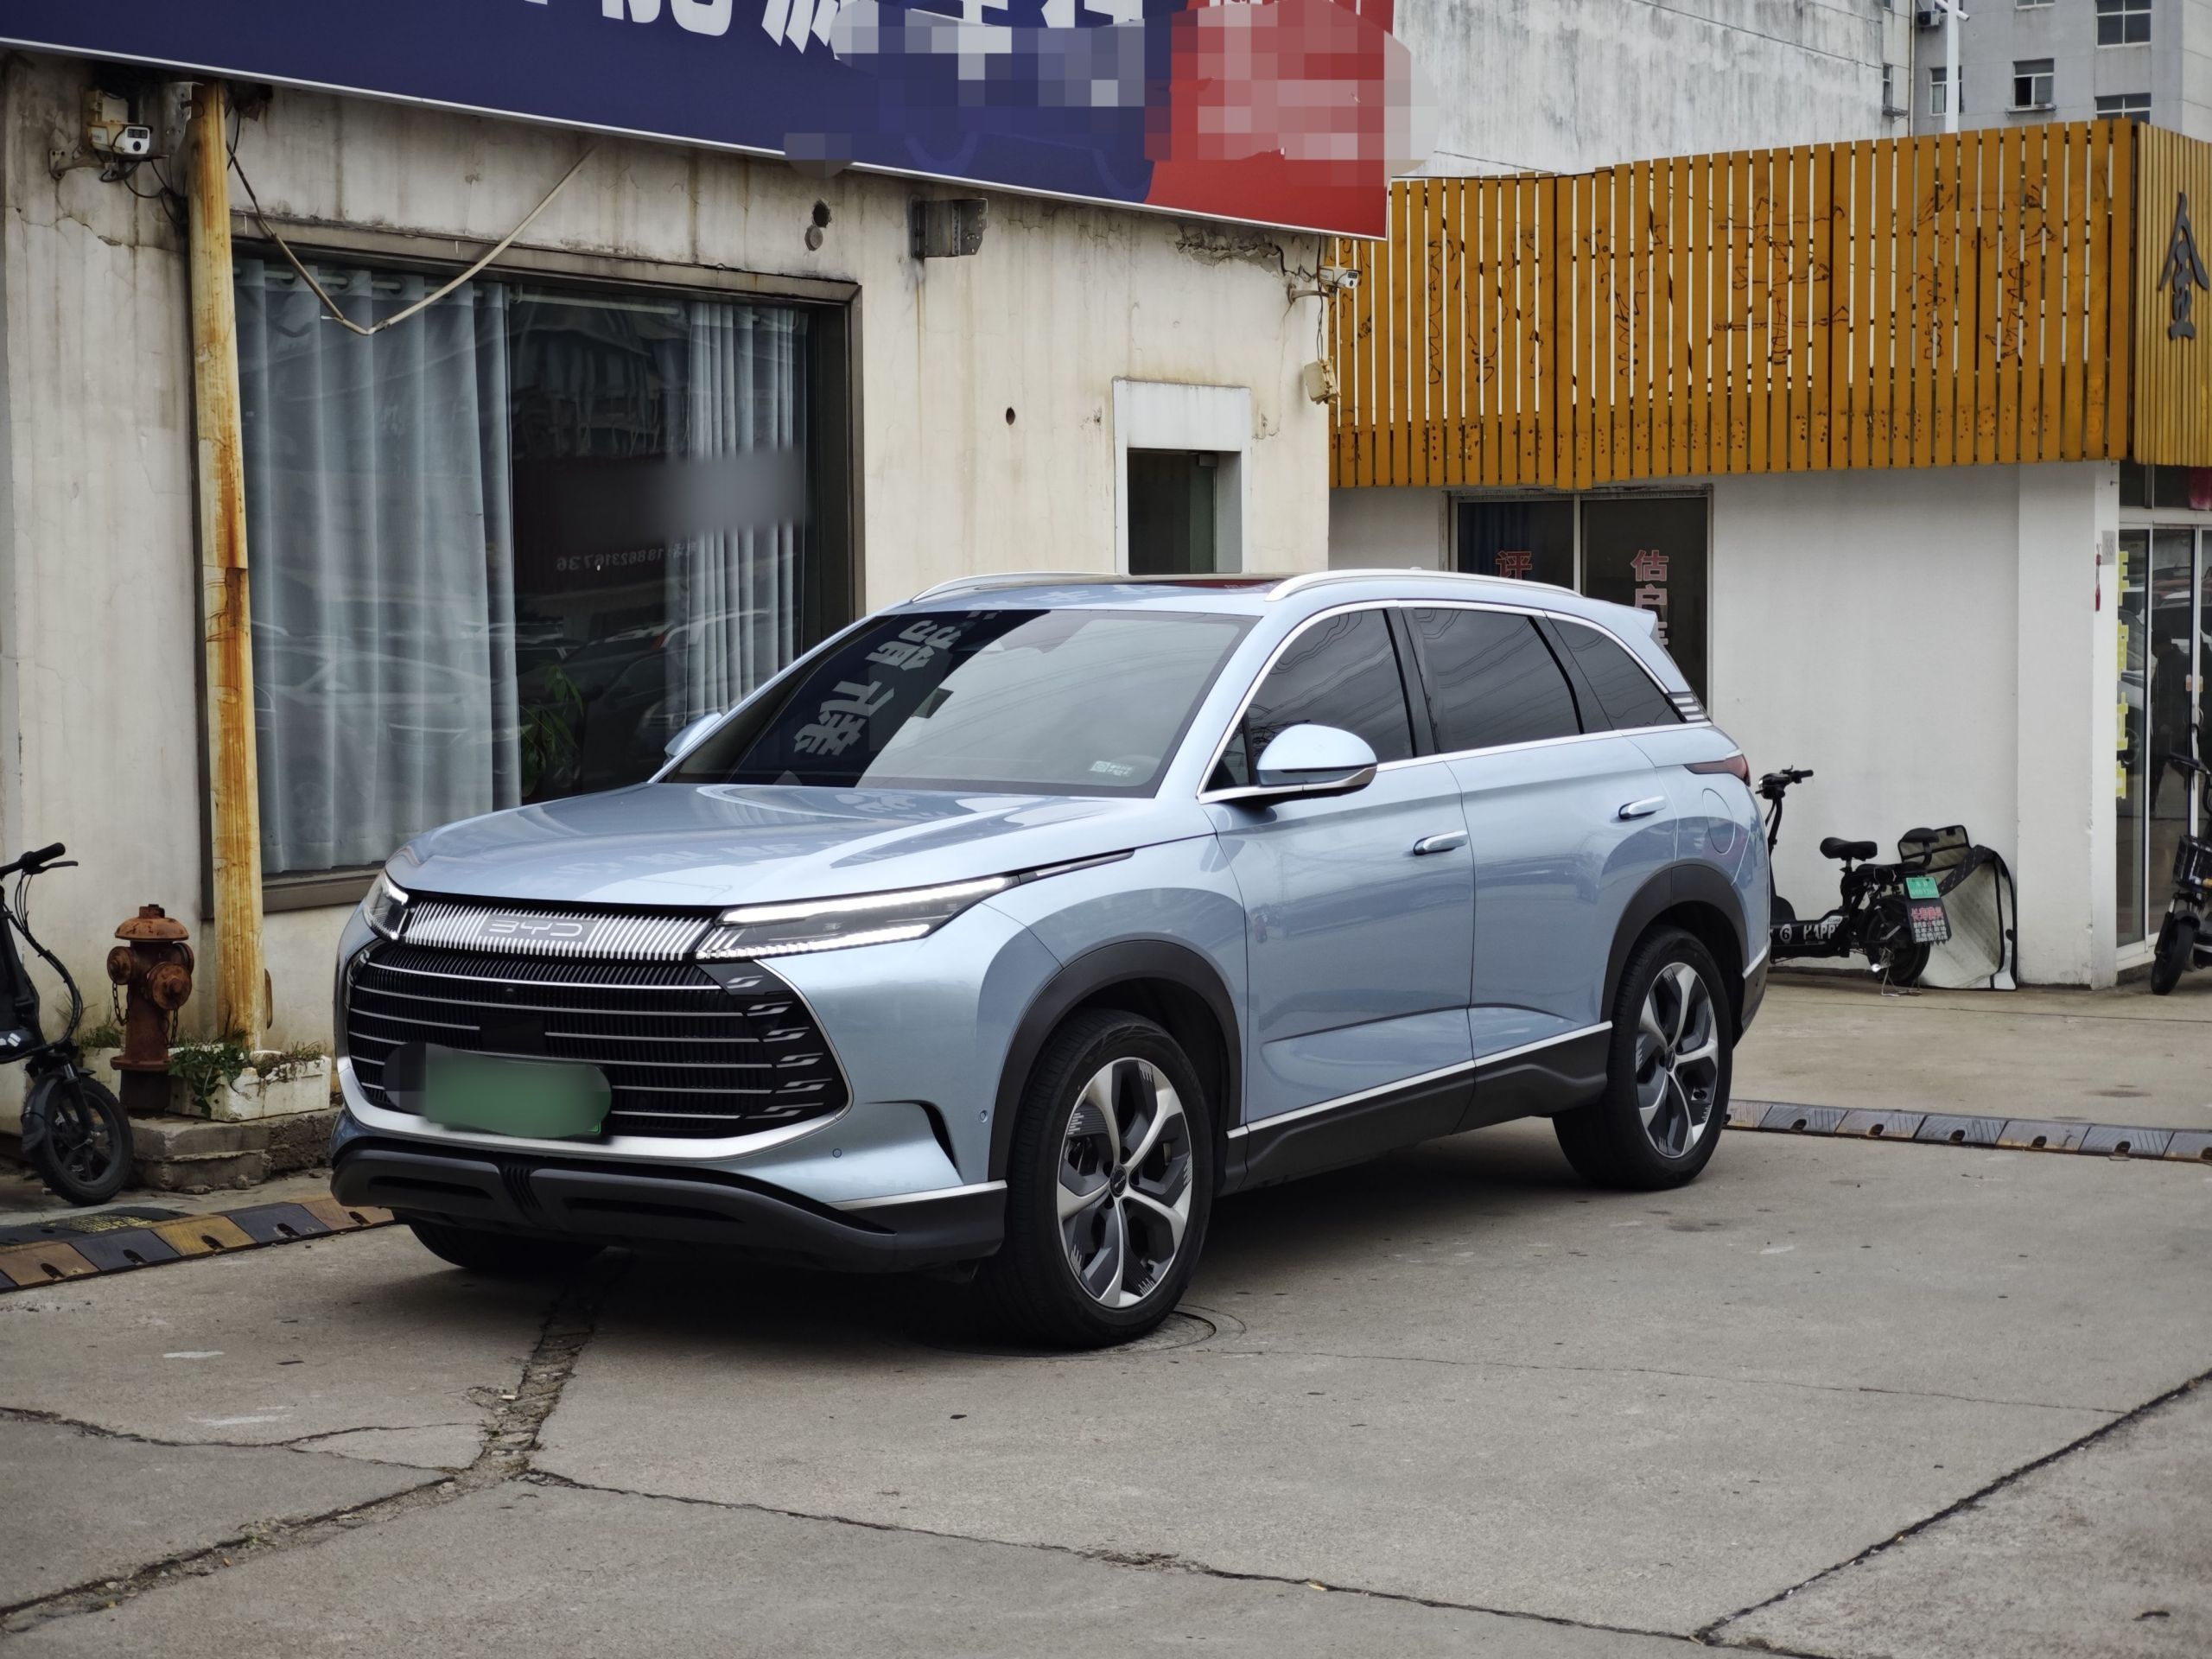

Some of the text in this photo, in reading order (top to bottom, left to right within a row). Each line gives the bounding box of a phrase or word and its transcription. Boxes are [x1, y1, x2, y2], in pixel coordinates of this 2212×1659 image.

[1495, 550, 1669, 582] 评 估
[487, 918, 583, 937] BYD
[1803, 925, 1840, 940] HAPP
